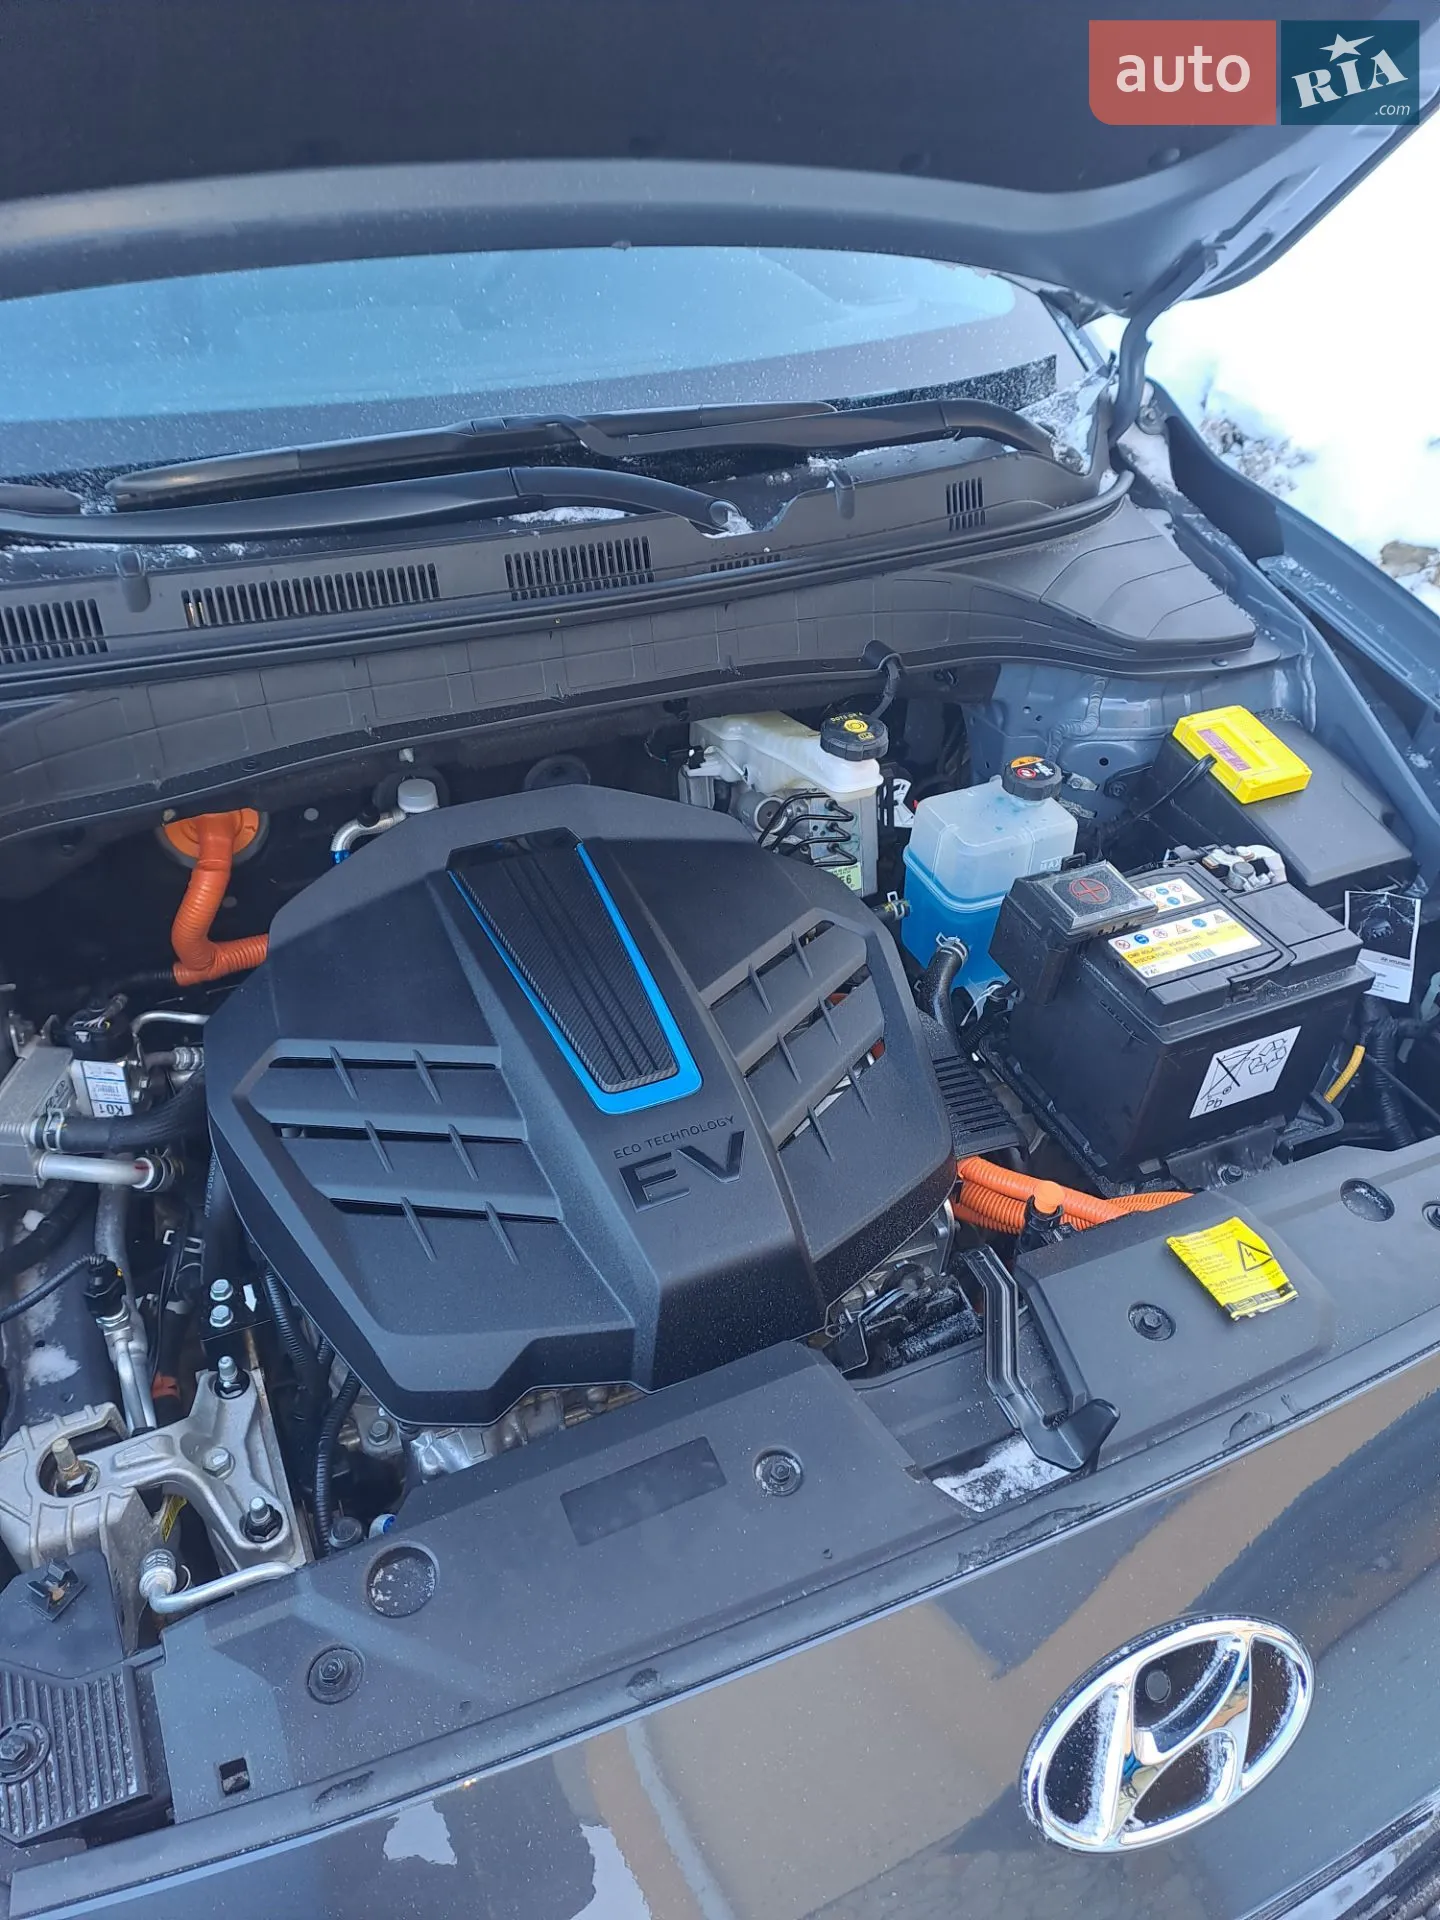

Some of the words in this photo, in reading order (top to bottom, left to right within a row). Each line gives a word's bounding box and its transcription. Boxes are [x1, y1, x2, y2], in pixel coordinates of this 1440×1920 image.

[1204, 1098, 1223, 1112] Pb
[613, 1143, 642, 1160] ECO
[644, 1115, 735, 1149] TECHNOLOGY
[618, 1130, 745, 1213] EV
